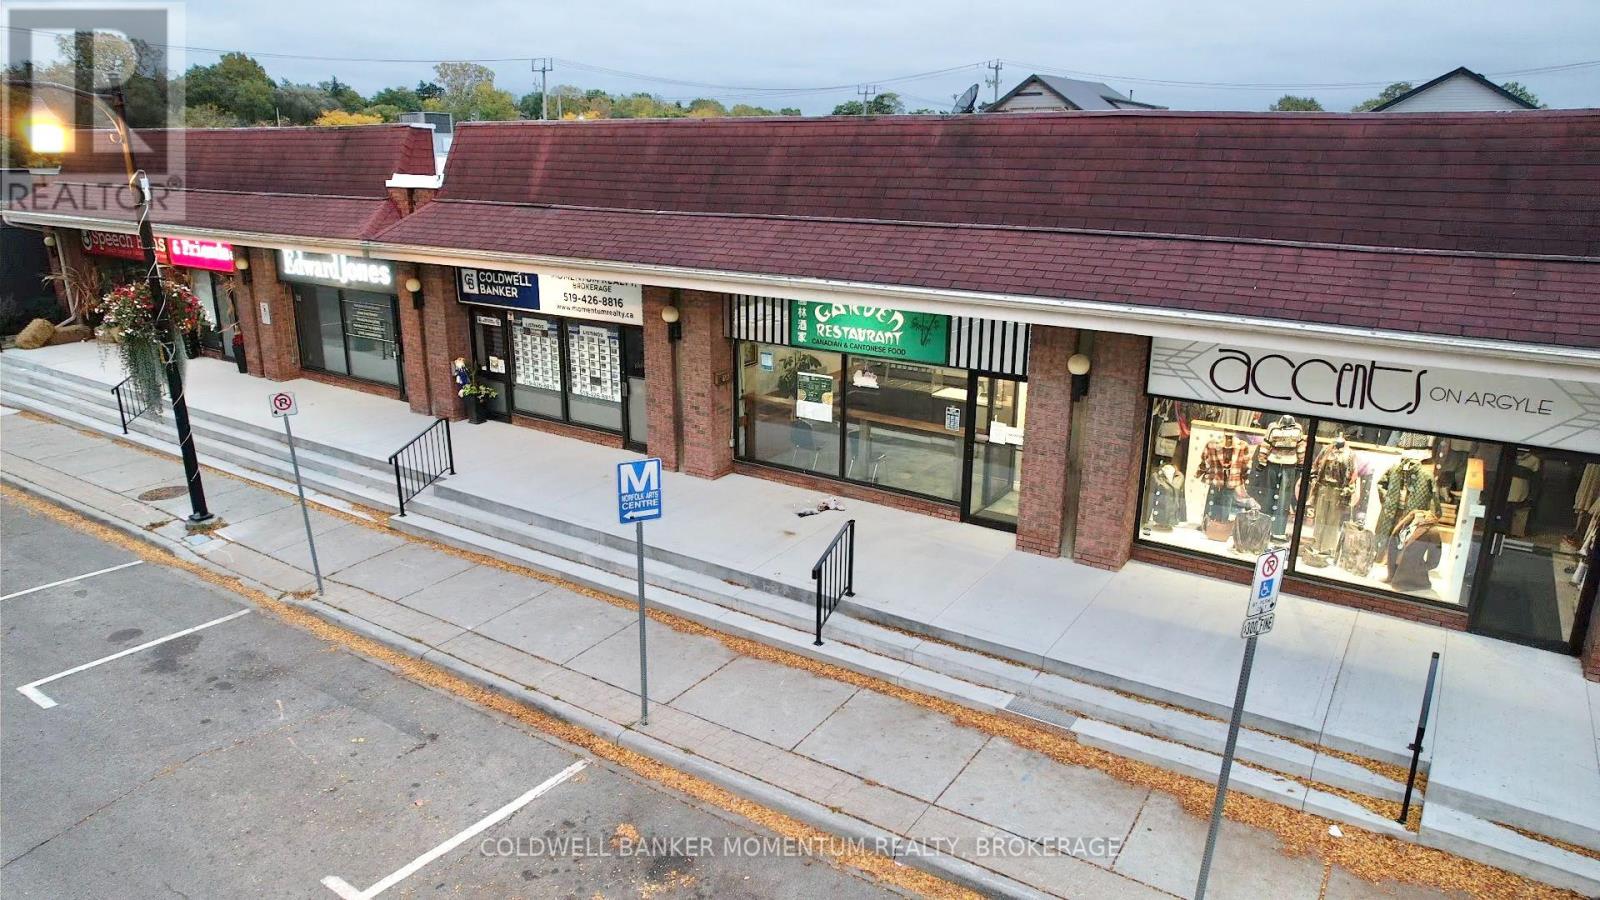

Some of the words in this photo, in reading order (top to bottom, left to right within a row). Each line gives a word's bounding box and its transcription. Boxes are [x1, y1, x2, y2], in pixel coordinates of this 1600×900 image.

[282, 249, 341, 280] Edward
[340, 255, 391, 285] Jones
[479, 272, 532, 287] COLDWELL
[480, 284, 518, 298] BANKER
[572, 282, 612, 293] BROKERAGE
[563, 292, 624, 308] 519-426-8816
[557, 305, 634, 319] www.momentumrealty.ca
[811, 338, 842, 348] CANADIAN
[849, 342, 887, 353] CANTONESE
[887, 347, 906, 356] FOOD
[1429, 386, 1462, 404] ON
[1465, 391, 1554, 415] ARGYLE
[620, 461, 658, 494] M
[621, 492, 644, 502] NORFOLK
[645, 491, 658, 499] ARTS
[621, 499, 659, 510] CENTRE
